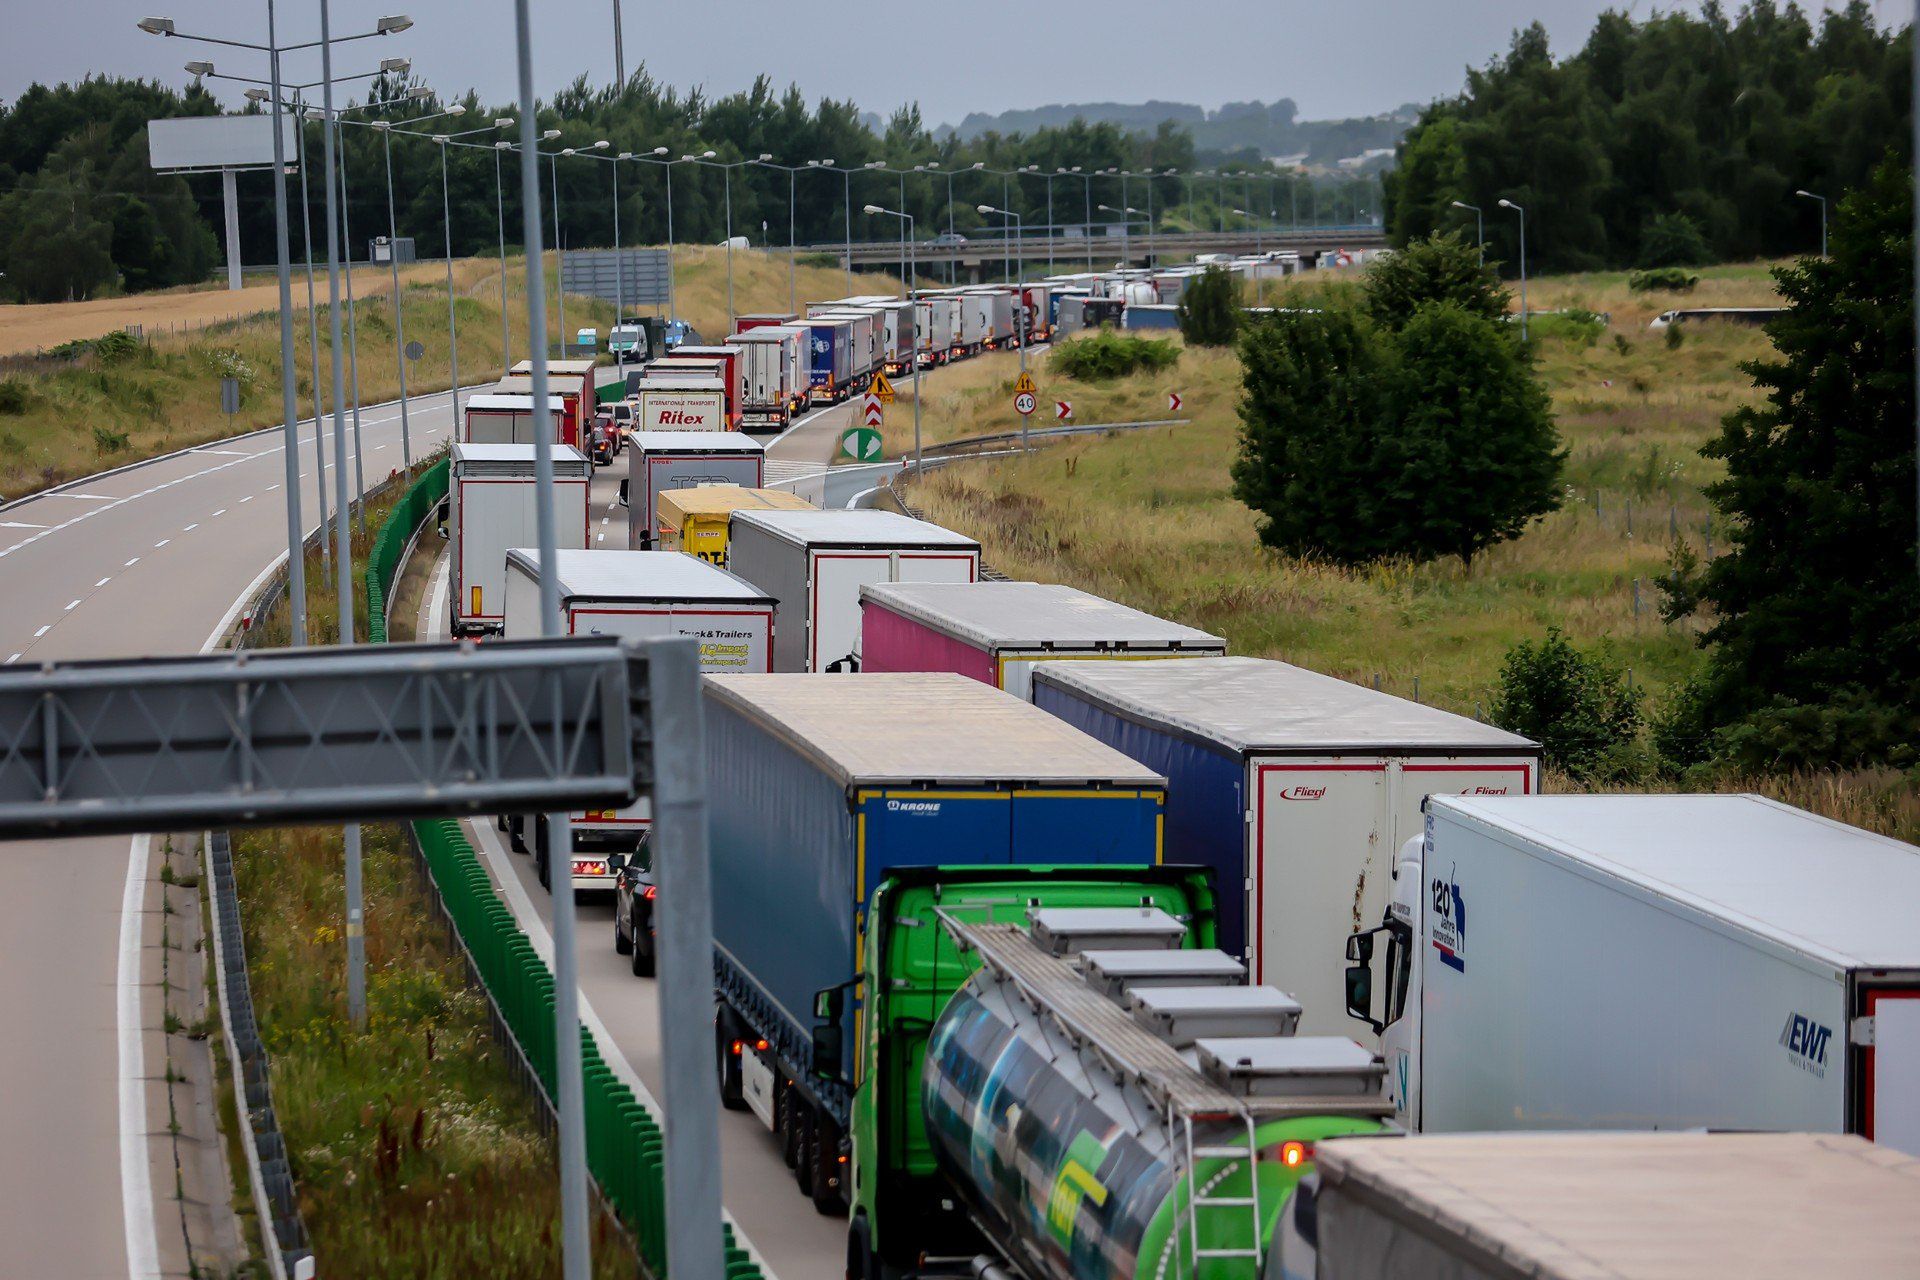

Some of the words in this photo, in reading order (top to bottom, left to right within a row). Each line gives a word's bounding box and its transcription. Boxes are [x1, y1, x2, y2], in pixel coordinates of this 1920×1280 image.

[1018, 398, 1034, 409] 40
[659, 410, 704, 425] Ritex
[1294, 786, 1327, 799] Fliegl
[900, 802, 941, 811] KRONE
[1432, 877, 1450, 919] 120
[1789, 1013, 1832, 1064] EWT
